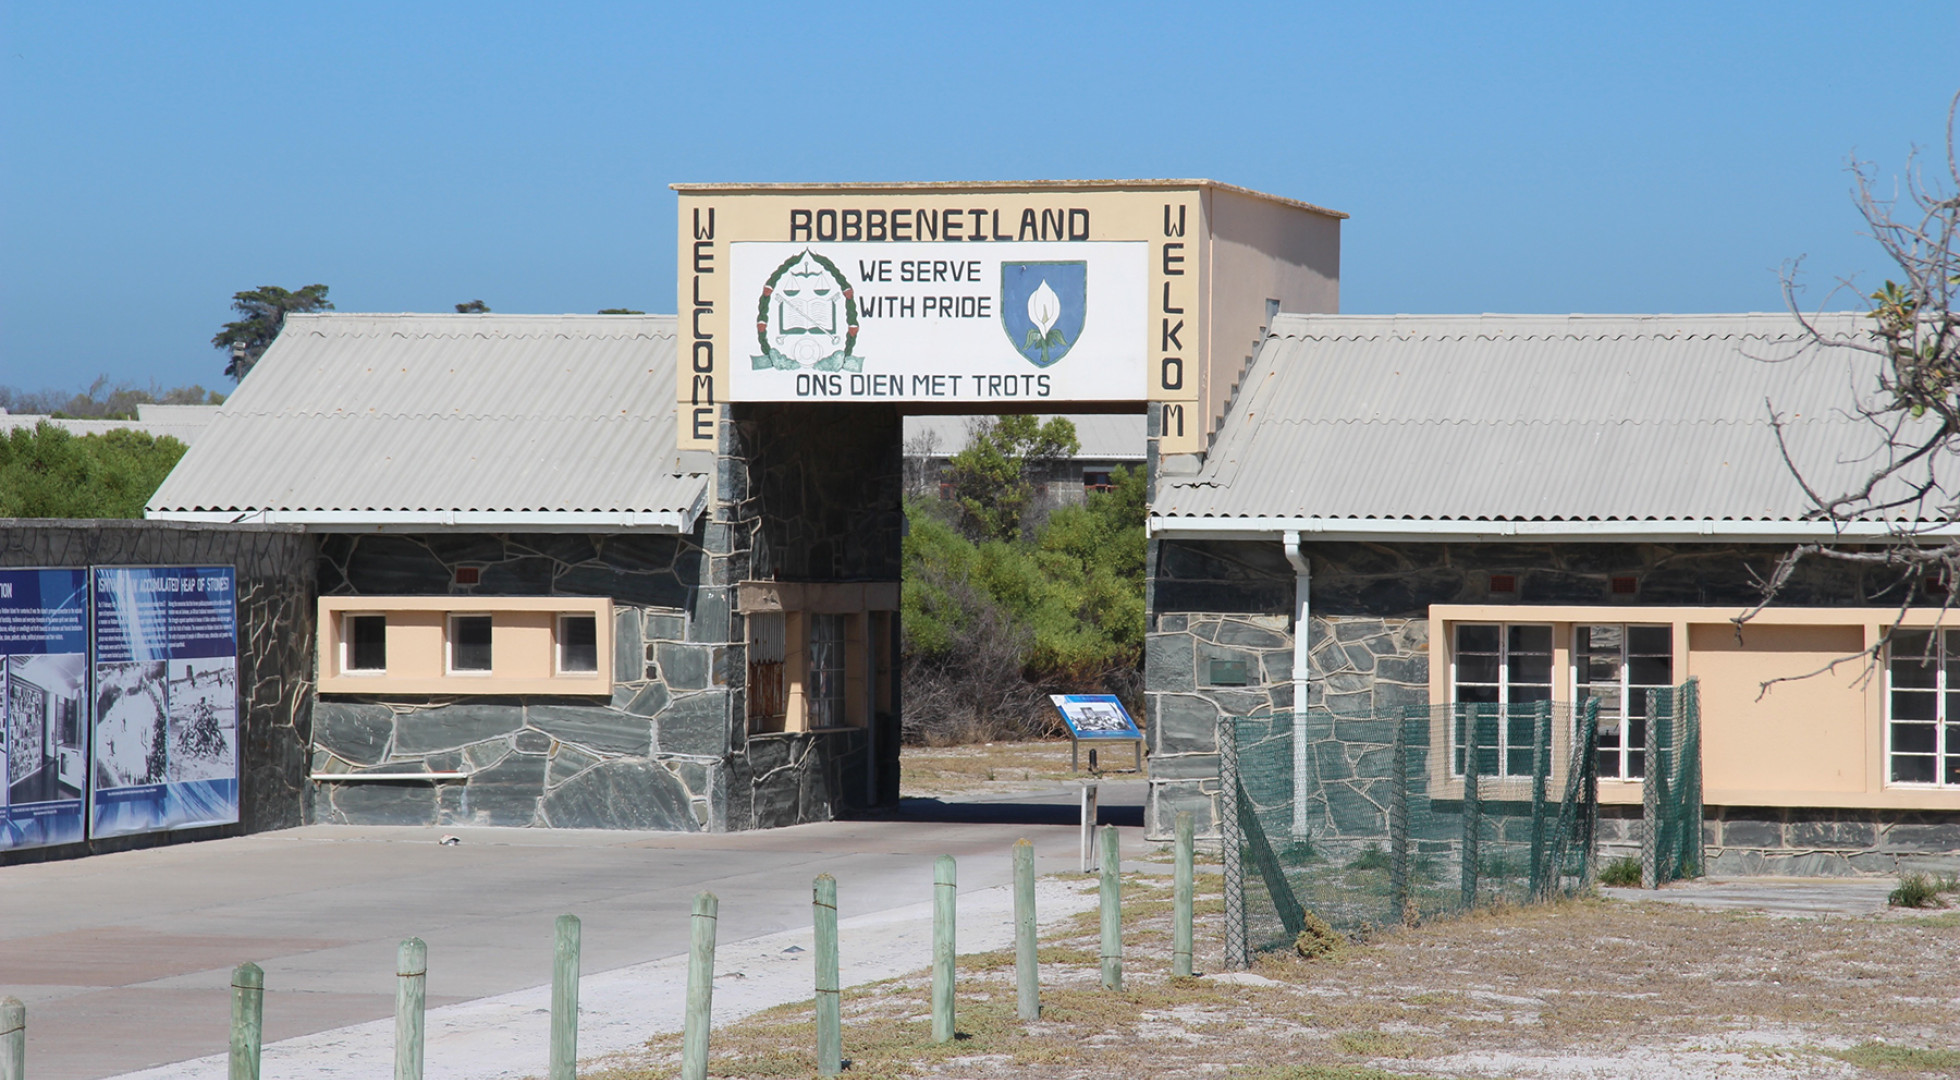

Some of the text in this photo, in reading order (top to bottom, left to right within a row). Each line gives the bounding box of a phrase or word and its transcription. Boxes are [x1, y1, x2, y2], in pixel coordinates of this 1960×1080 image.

[790, 208, 1090, 242] ROBBENEILAND
[859, 259, 981, 282] WE SERVE
[859, 296, 991, 318] WITH PRIDE
[690, 207, 715, 441] WELCOME
[1161, 204, 1186, 438] WELKOM
[796, 374, 1050, 397] ONS DIEN MET TROTS
[181, 576, 196, 592] HEAP
[196, 577, 206, 591] OF
